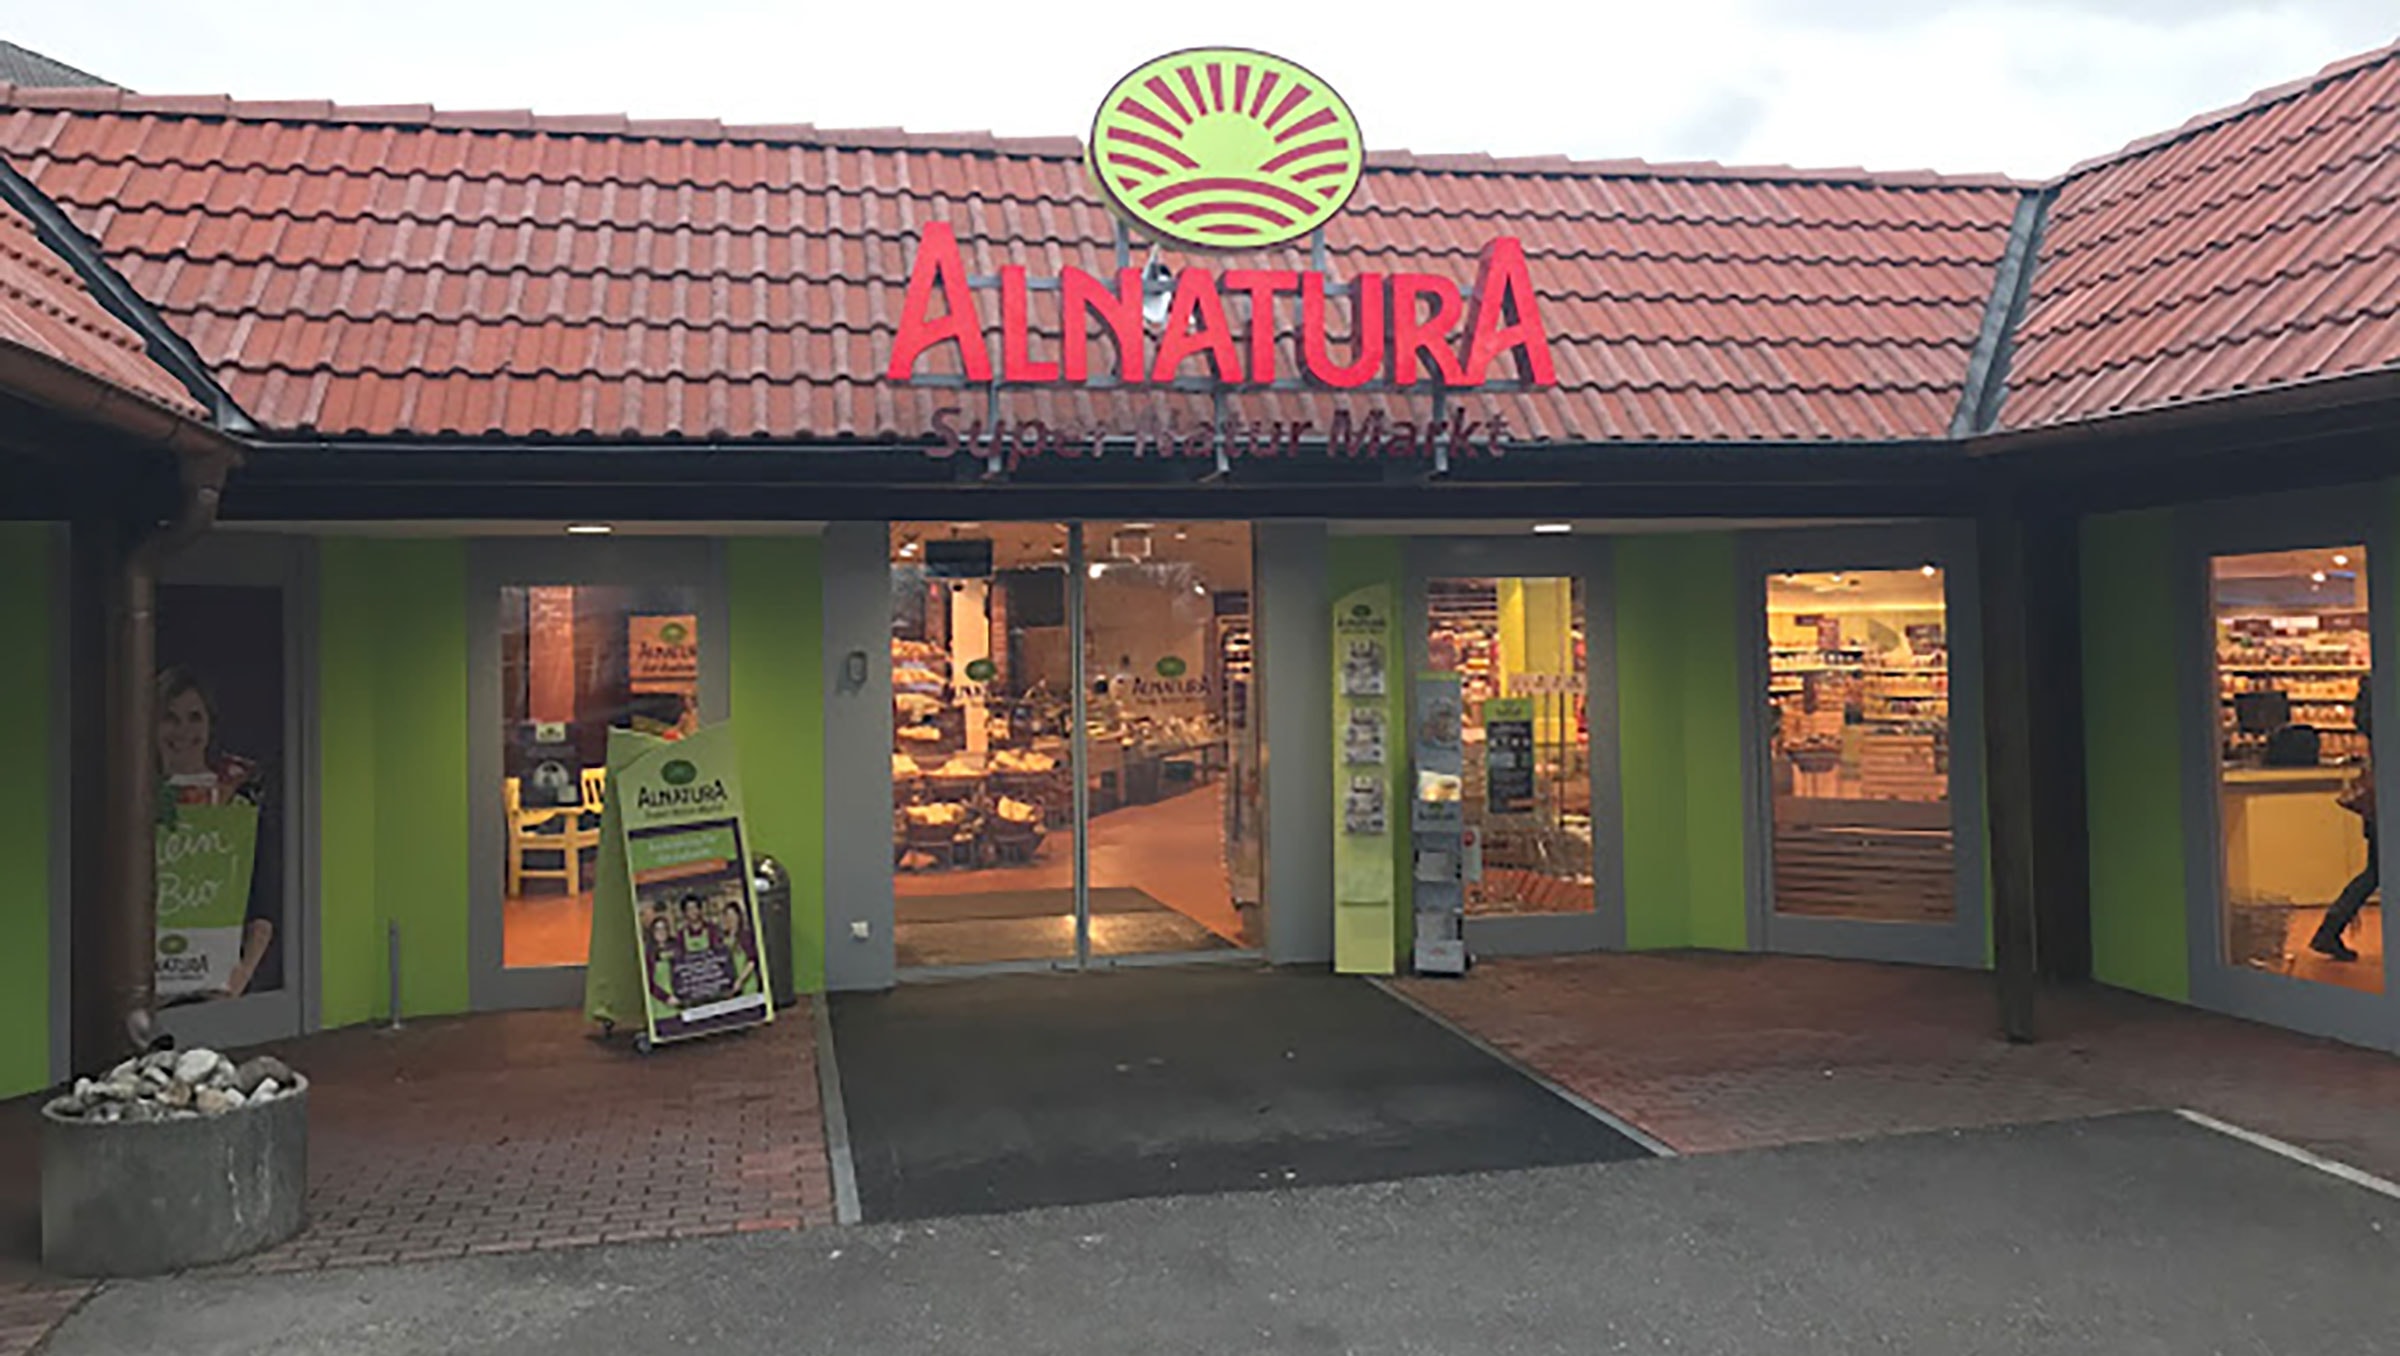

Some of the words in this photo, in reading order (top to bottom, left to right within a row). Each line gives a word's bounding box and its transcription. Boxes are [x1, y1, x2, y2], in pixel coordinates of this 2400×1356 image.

[886, 221, 1556, 388] ALNATURA
[922, 407, 1105, 472] Super
[1134, 409, 1314, 459] Natur
[1327, 407, 1511, 460] Markt
[638, 779, 728, 808] ALNATURA
